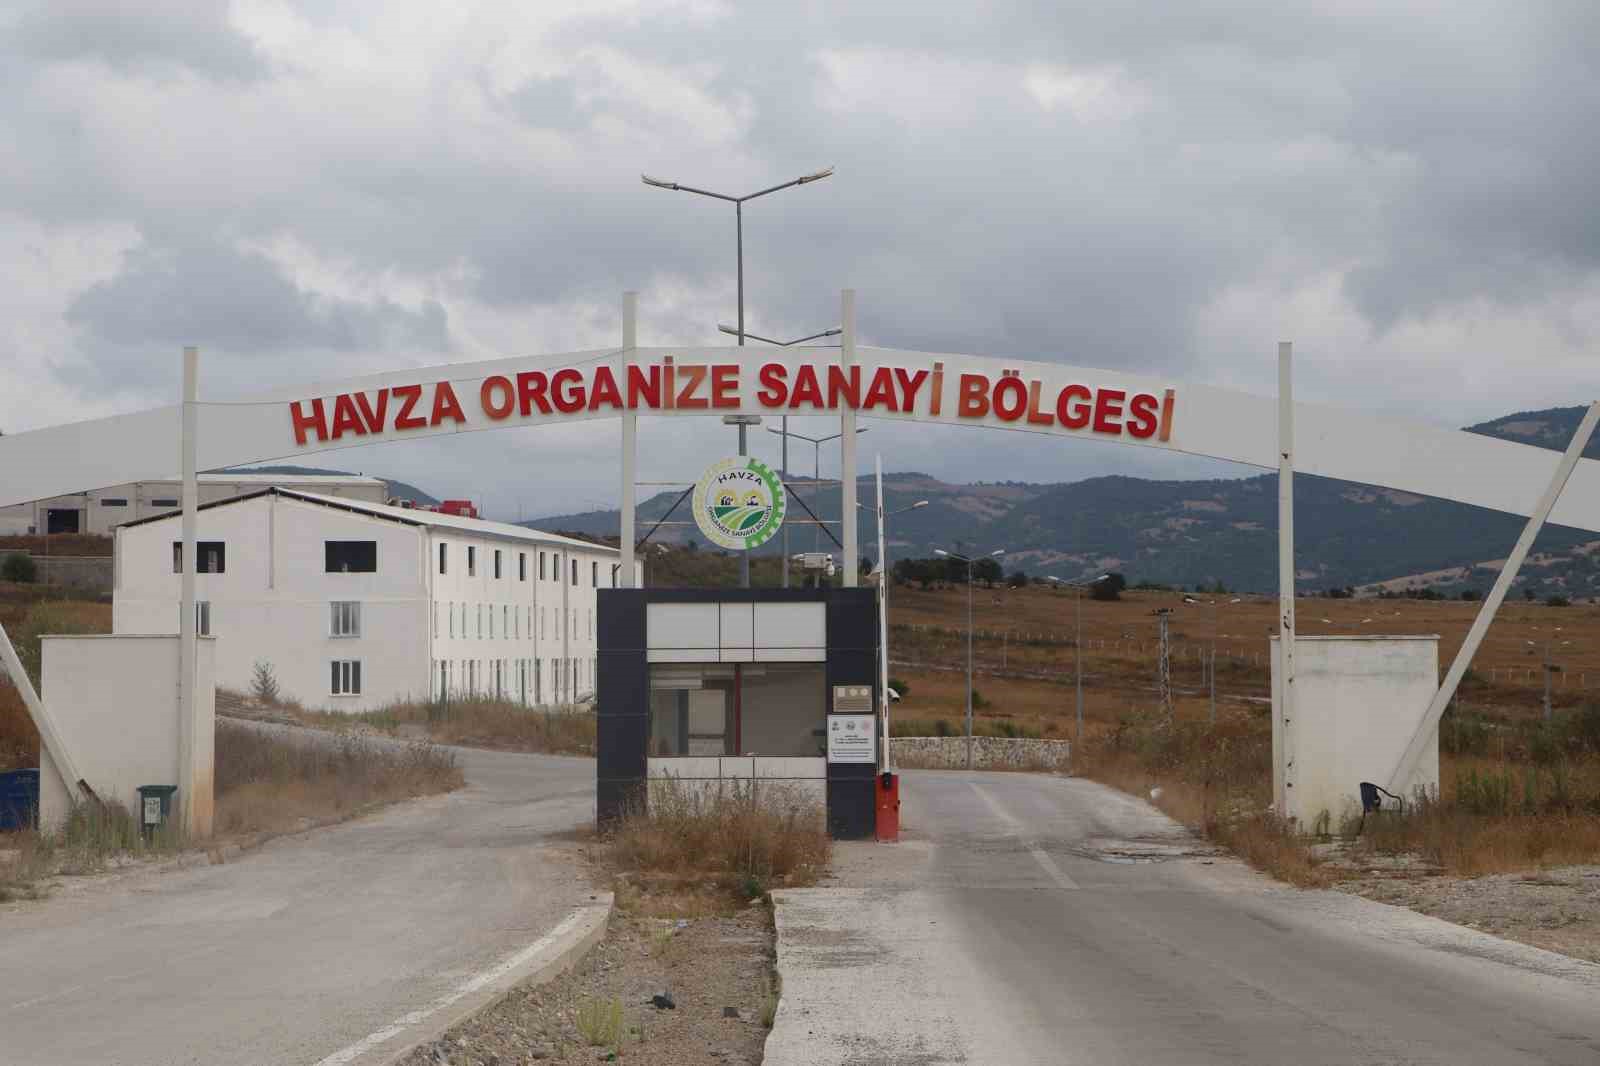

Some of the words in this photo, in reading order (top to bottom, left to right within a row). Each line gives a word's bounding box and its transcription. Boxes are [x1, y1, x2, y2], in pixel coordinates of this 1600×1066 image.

[290, 380, 465, 445] HAVZA
[480, 356, 741, 421] ORGANİZE
[757, 362, 944, 416] SANAYİ
[958, 369, 1175, 442] BÖLGESİ
[718, 471, 762, 486] HAVZA
